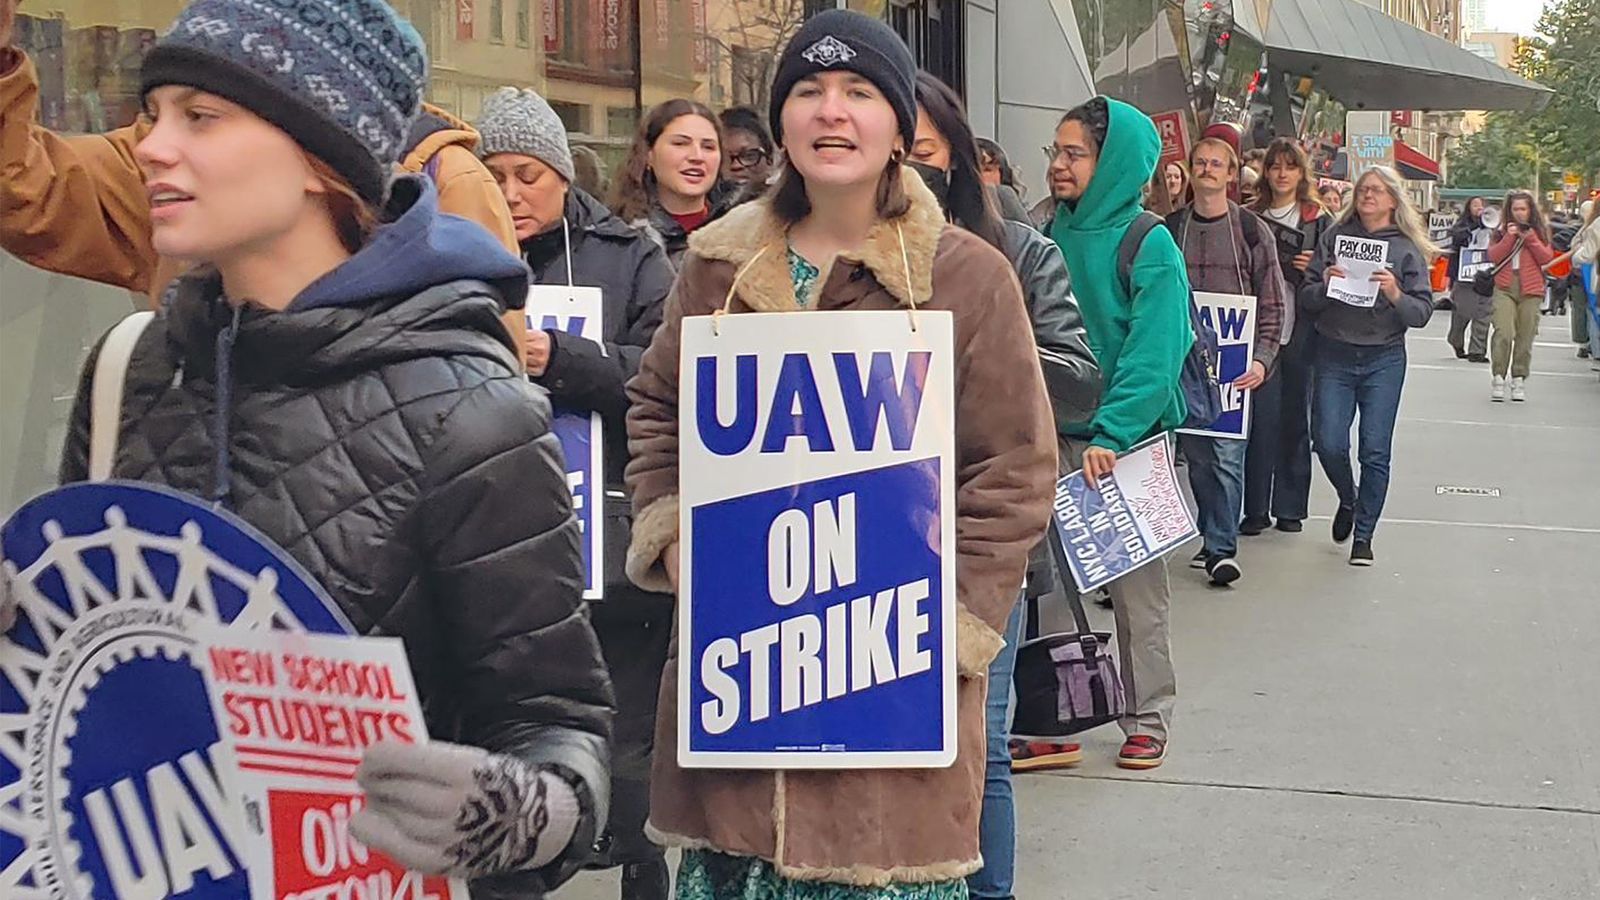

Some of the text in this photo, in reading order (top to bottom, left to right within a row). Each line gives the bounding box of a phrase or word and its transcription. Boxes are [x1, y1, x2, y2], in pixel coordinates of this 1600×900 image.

[1356, 147, 1384, 158] WITH
[1361, 135, 1393, 147] STAND
[1431, 217, 1454, 227] UAW
[1338, 250, 1382, 263] PROFESSORS
[1340, 239, 1383, 256] PAY OUR
[1199, 305, 1249, 340] AW
[695, 351, 933, 457] UAW
[1087, 509, 1112, 534] IN
[1097, 476, 1148, 564] SOLIDARIT
[767, 492, 857, 606] ON
[1076, 542, 1109, 583] NYC
[208, 646, 406, 701] NEW SCHOOL
[700, 577, 932, 735] STRIKE
[222, 692, 415, 748] STUDENTS
